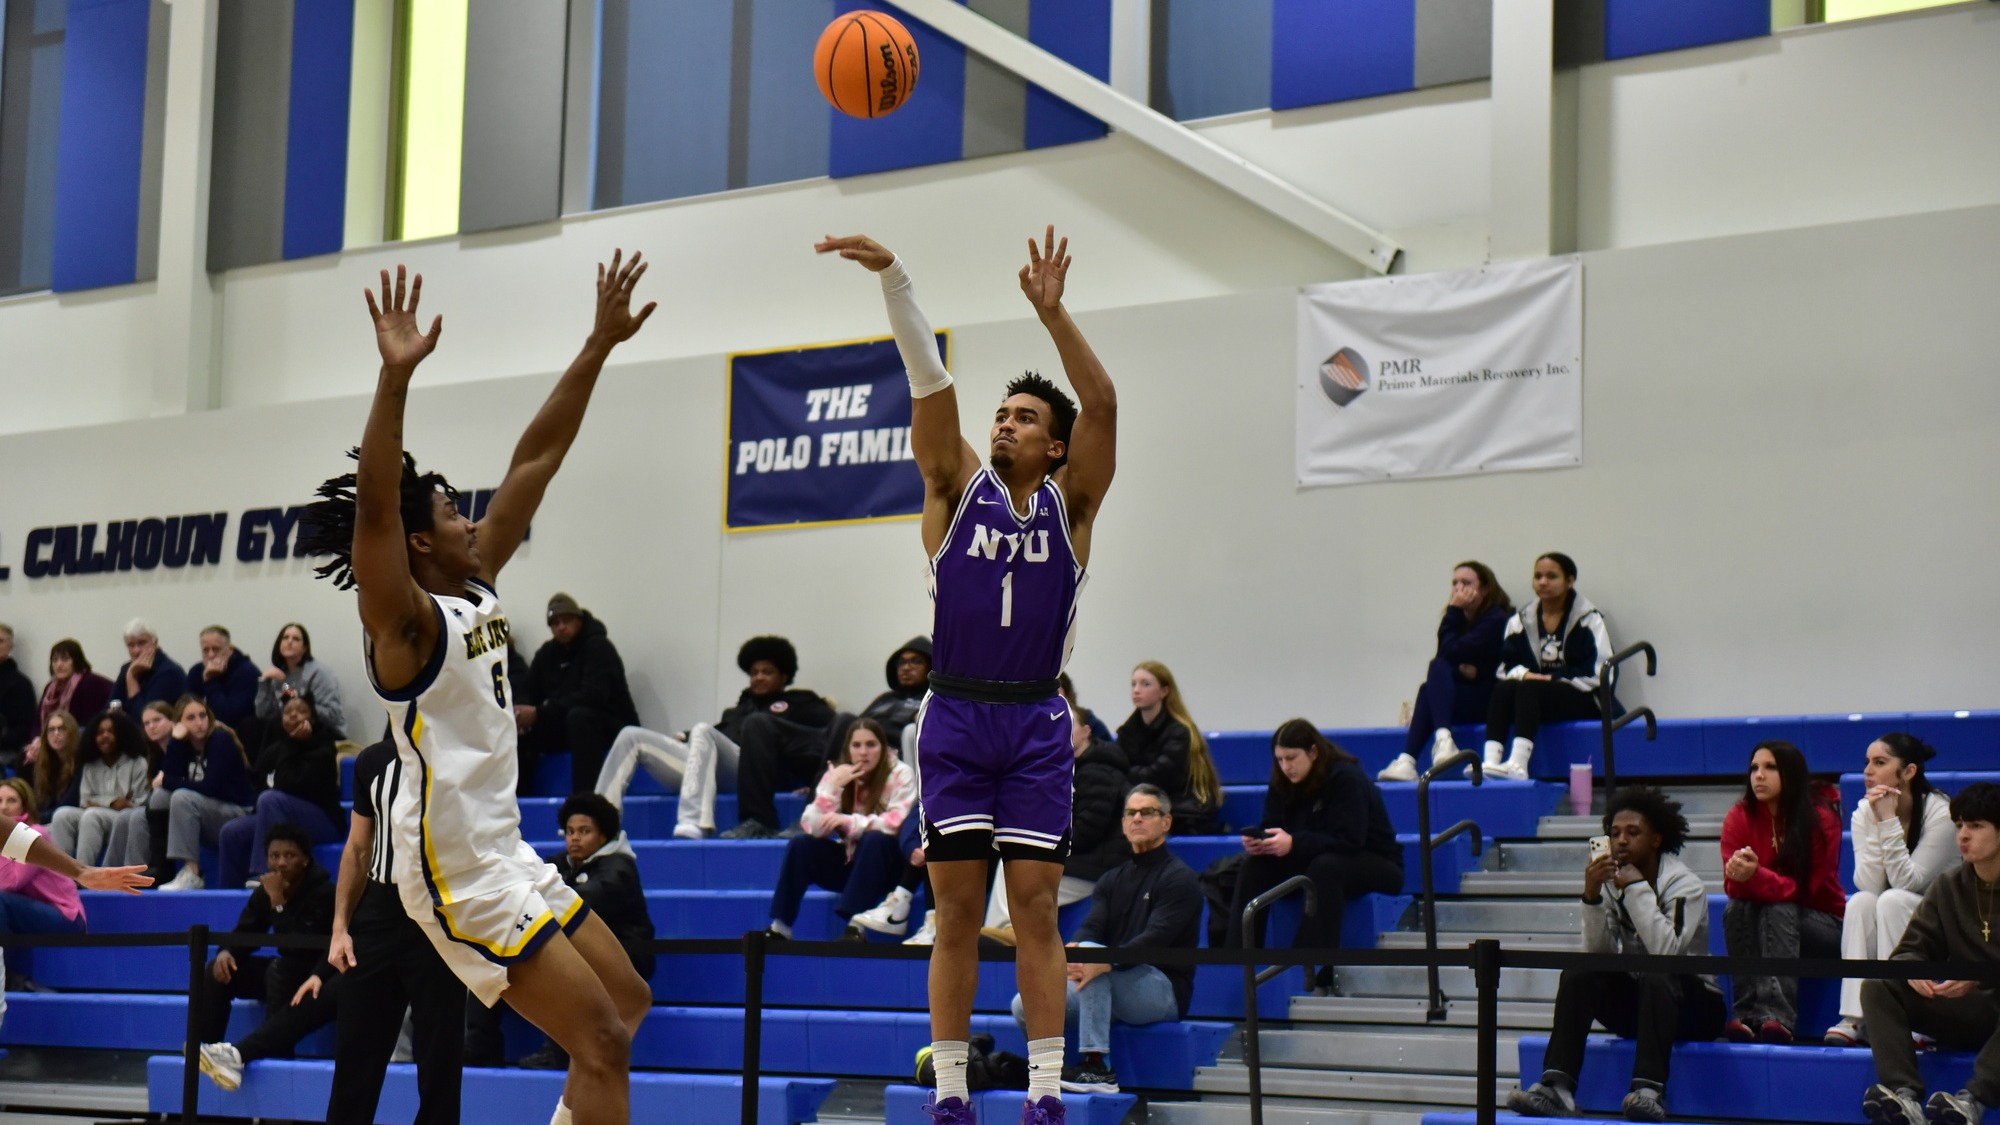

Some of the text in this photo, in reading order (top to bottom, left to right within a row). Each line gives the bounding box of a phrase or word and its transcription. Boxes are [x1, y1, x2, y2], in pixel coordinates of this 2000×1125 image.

[879, 43, 897, 111] Wilson
[1378, 363, 1571, 391] Prime Materials Recovery Inc.
[1379, 358, 1422, 376] PMR
[806, 384, 873, 422] THE
[735, 434, 812, 475] POLO
[23, 511, 228, 578] CALHOUN
[966, 523, 1050, 563] NYU
[1001, 571, 1013, 627] 1
[463, 624, 489, 660] BUE
[491, 659, 507, 710] 6
